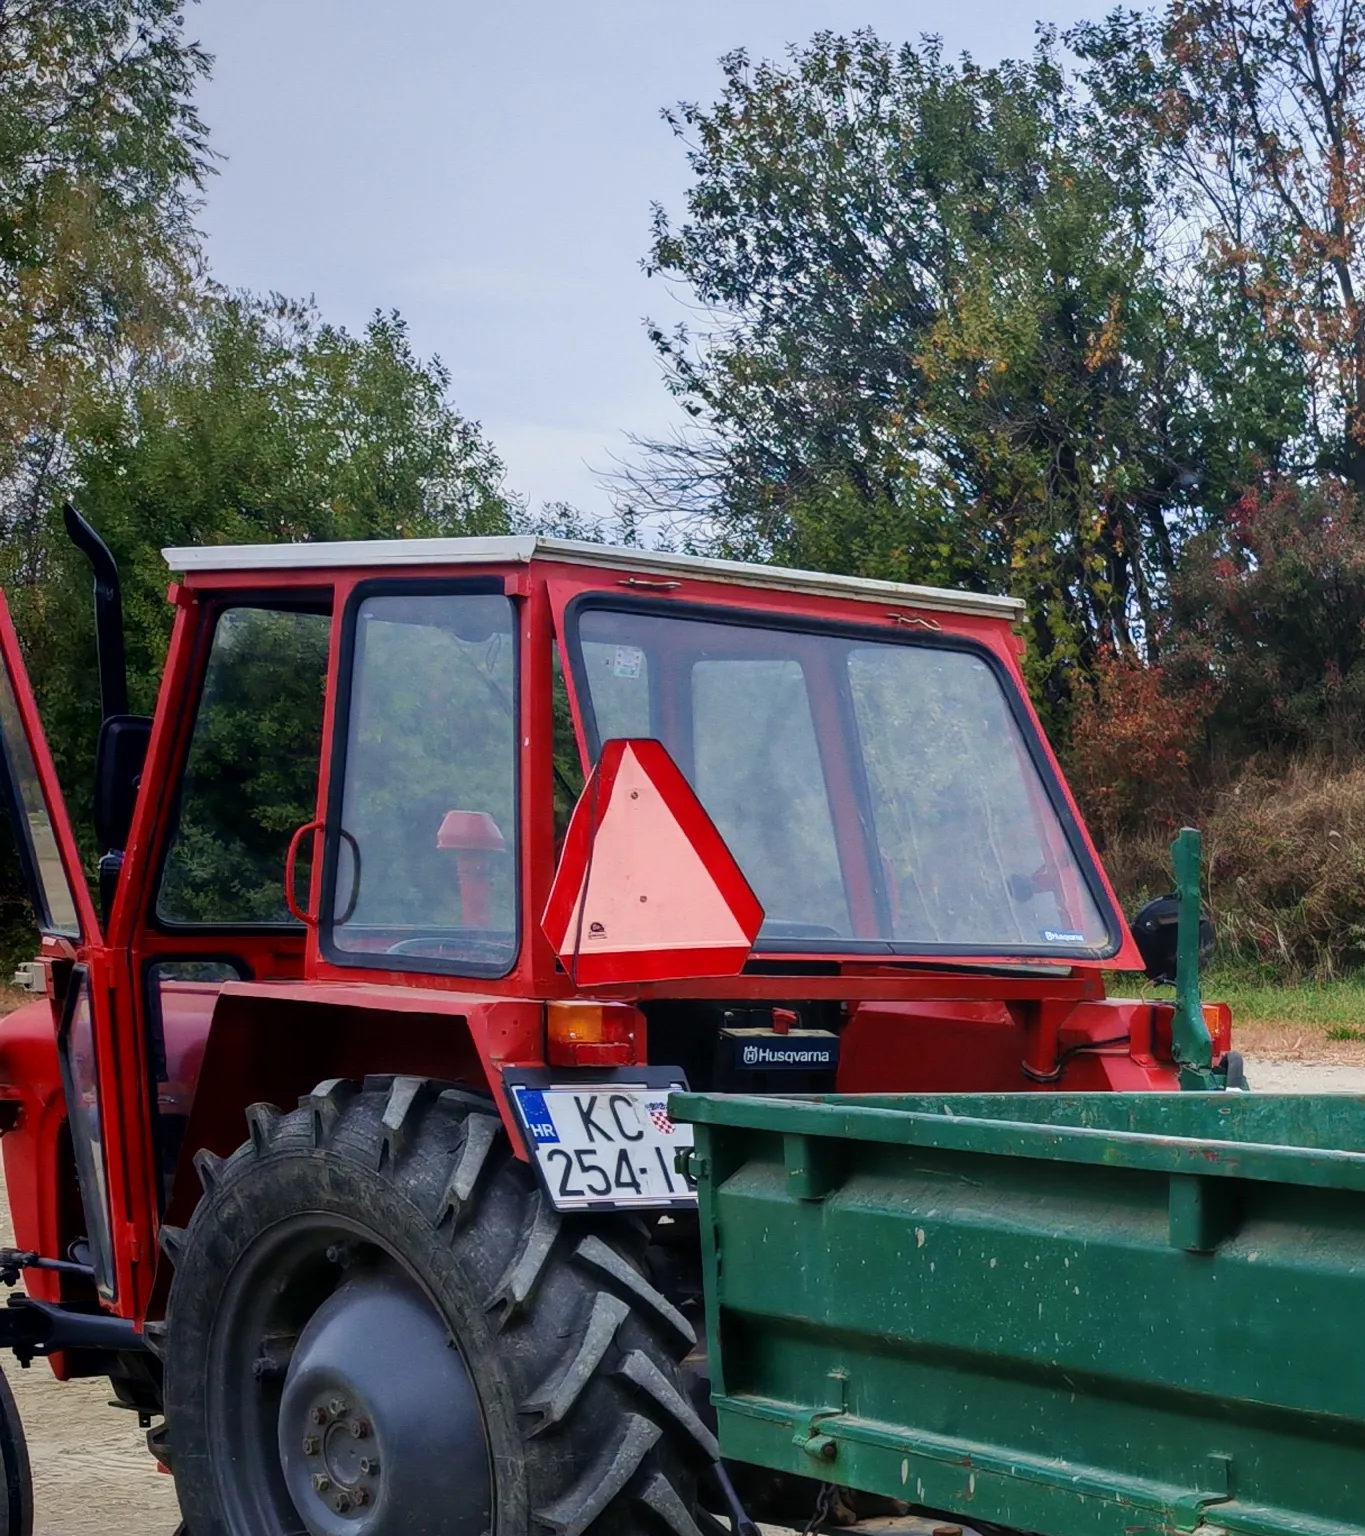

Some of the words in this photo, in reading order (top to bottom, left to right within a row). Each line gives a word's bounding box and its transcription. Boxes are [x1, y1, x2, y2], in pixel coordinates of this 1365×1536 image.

[758, 1048, 830, 1064] Husqvarna
[573, 1095, 644, 1143] KC
[532, 1123, 556, 1137] HR
